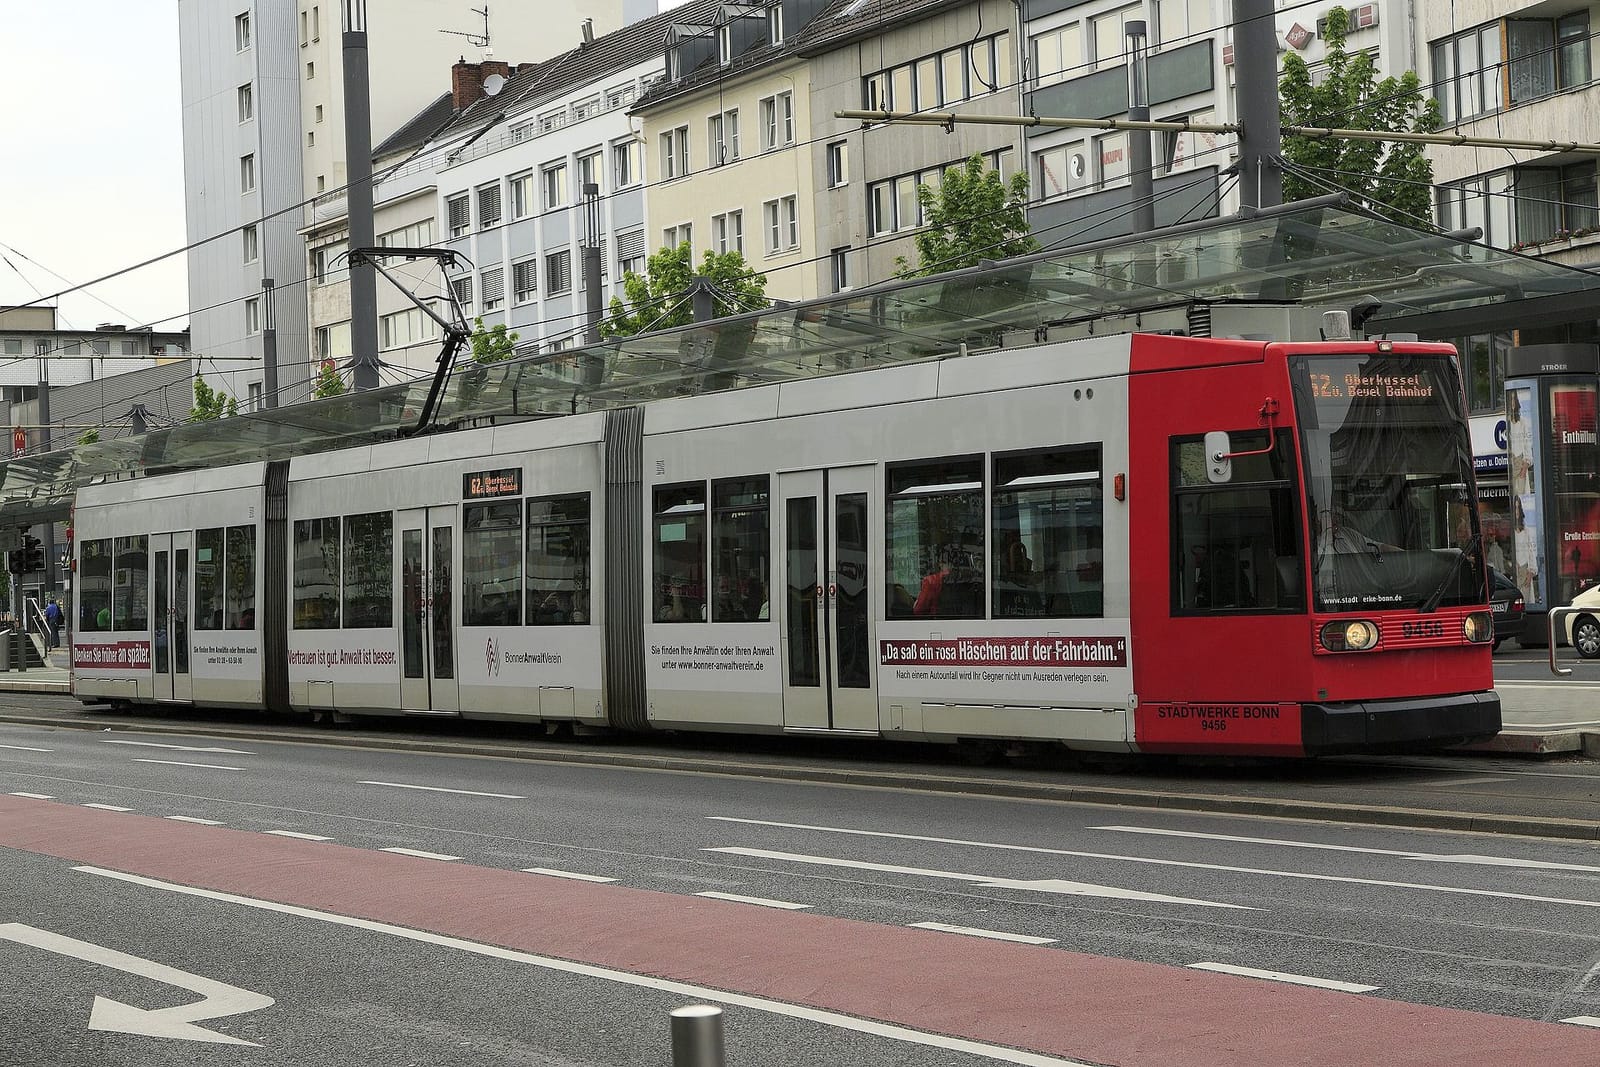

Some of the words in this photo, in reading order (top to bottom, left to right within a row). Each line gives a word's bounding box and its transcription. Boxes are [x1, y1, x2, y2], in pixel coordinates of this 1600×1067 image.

[1386, 385, 1433, 397] Bahnhof
[1402, 621, 1443, 638] 9456
[118, 648, 127, 663] an
[287, 649, 316, 664] Vertrauen
[317, 649, 326, 664] ist
[340, 648, 362, 664] Anwalt
[363, 648, 372, 664] ist
[651, 646, 660, 655] Sie
[661, 645, 680, 655] finden
[720, 646, 734, 656] oder
[752, 646, 774, 656] Anwalt
[900, 643, 917, 660] saß
[919, 643, 934, 660] ein
[935, 646, 956, 660] rosa
[959, 640, 1007, 660] Häschen
[1010, 640, 1029, 660] auf
[1032, 640, 1052, 660] der
[662, 660, 677, 669] unter
[896, 670, 910, 679] Nach
[912, 670, 928, 679] einem
[959, 670, 971, 680] wird
[982, 671, 1004, 682] Gegner
[1005, 671, 1020, 681] nicht
[1021, 673, 1031, 681] um
[1033, 672, 1063, 682] Ausreden
[1063, 672, 1092, 684] verlegen
[1158, 706, 1239, 719] STADTWERKE
[1243, 706, 1279, 719] BONN
[1201, 720, 1226, 731] 9456
